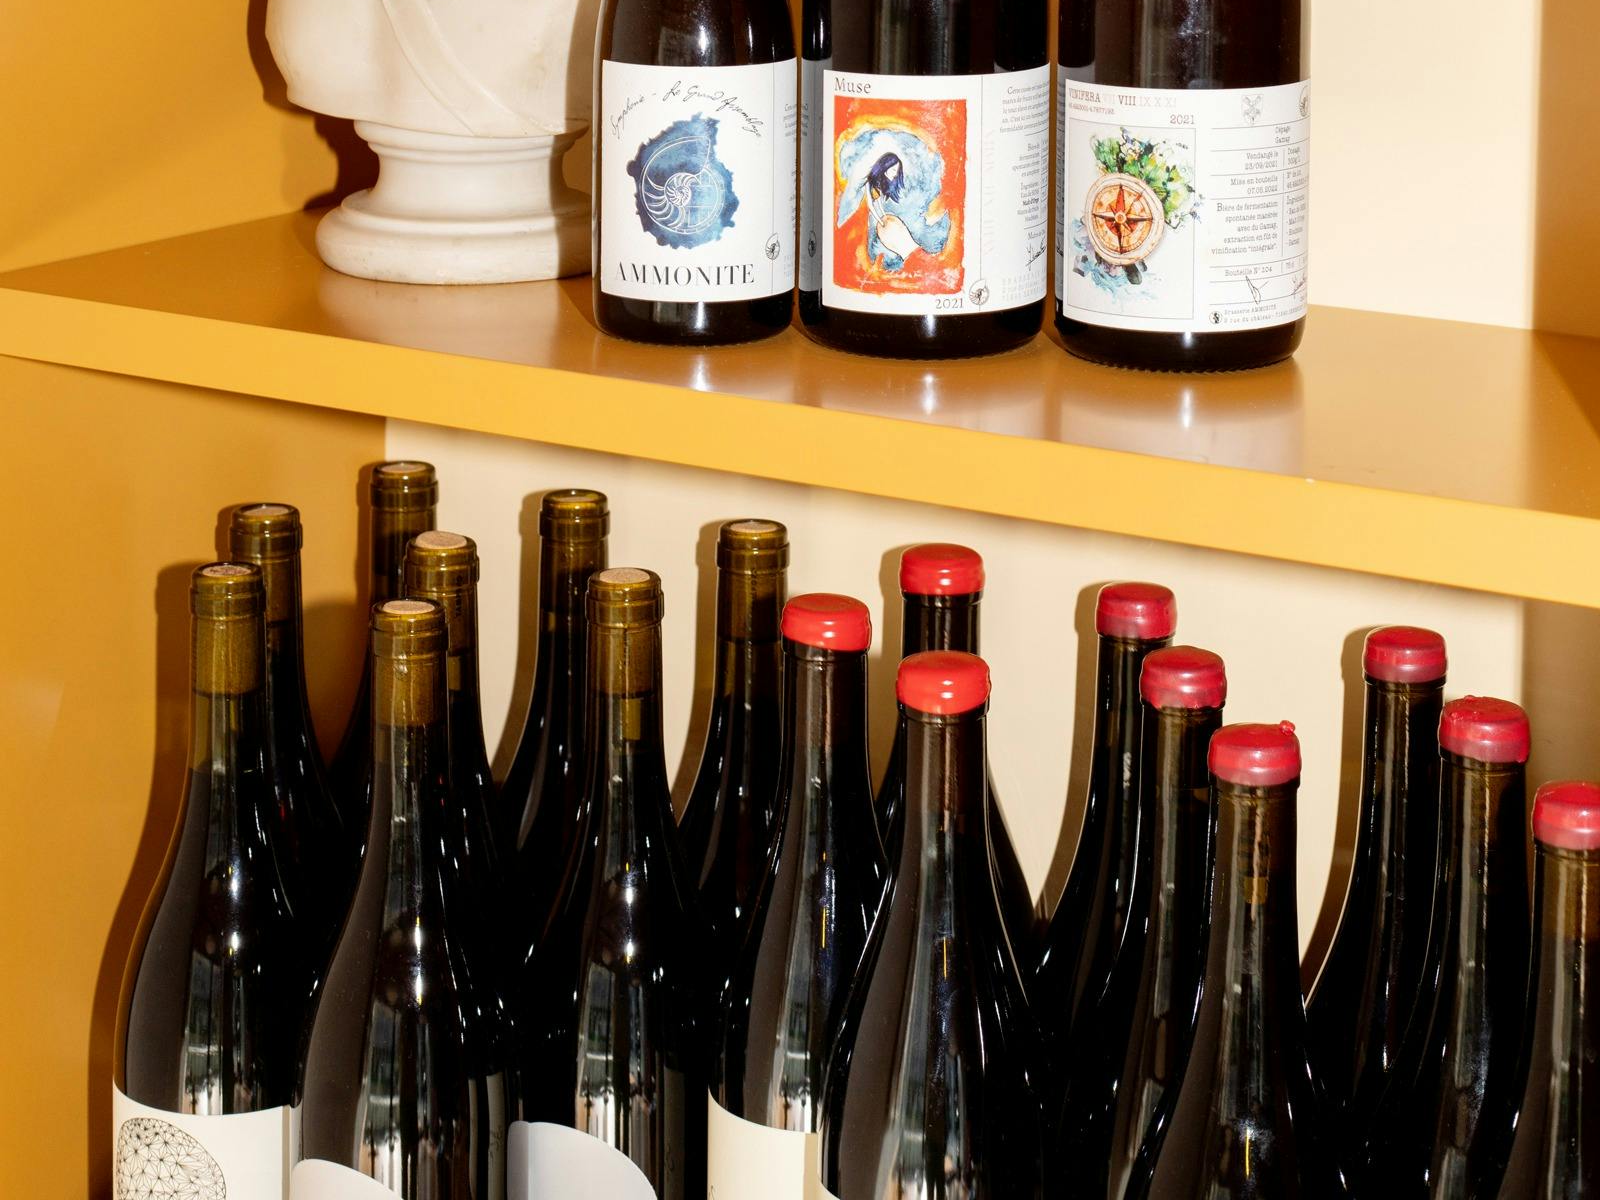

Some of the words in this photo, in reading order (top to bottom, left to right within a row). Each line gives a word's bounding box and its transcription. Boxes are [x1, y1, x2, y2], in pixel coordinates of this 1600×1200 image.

[834, 76, 872, 94] Muse
[1068, 87, 1101, 103] VINIFERA
[1117, 94, 1137, 106] VIII
[1169, 114, 1195, 125] 2021
[1230, 177, 1246, 186] Mise
[1216, 202, 1235, 212] Bière
[1236, 203, 1243, 211] de
[1251, 223, 1258, 231] du
[1223, 235, 1255, 243] extraction
[1211, 246, 1248, 255] vinification
[615, 261, 755, 286] AMMONITE
[935, 297, 963, 310] 2021
